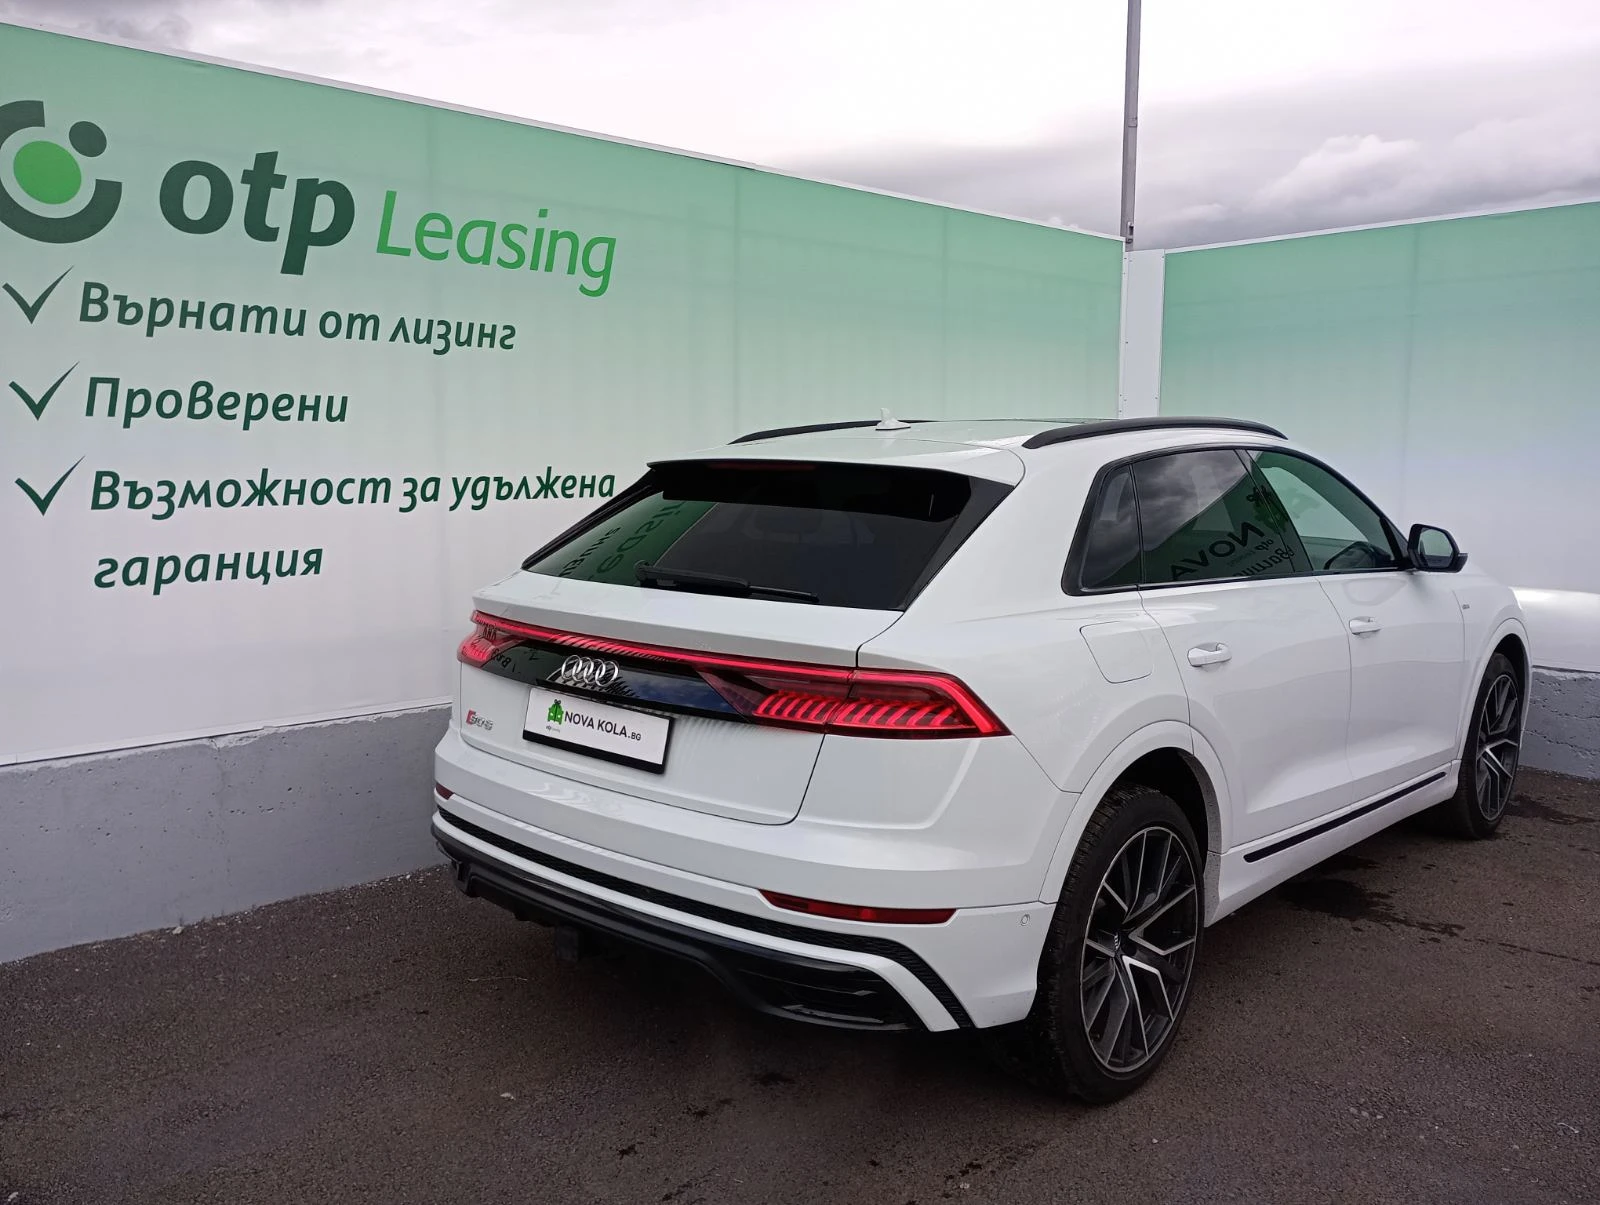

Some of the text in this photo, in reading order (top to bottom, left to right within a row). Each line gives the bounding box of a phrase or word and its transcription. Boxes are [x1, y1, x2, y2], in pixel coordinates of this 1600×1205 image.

[160, 151, 616, 297] otp Leasing
[80, 282, 515, 355] Върнати от лизинг
[86, 377, 348, 430] Проверени
[91, 466, 615, 520] Възможност за удължена
[94, 549, 322, 595] гаранция
[565, 711, 594, 729] NOVA
